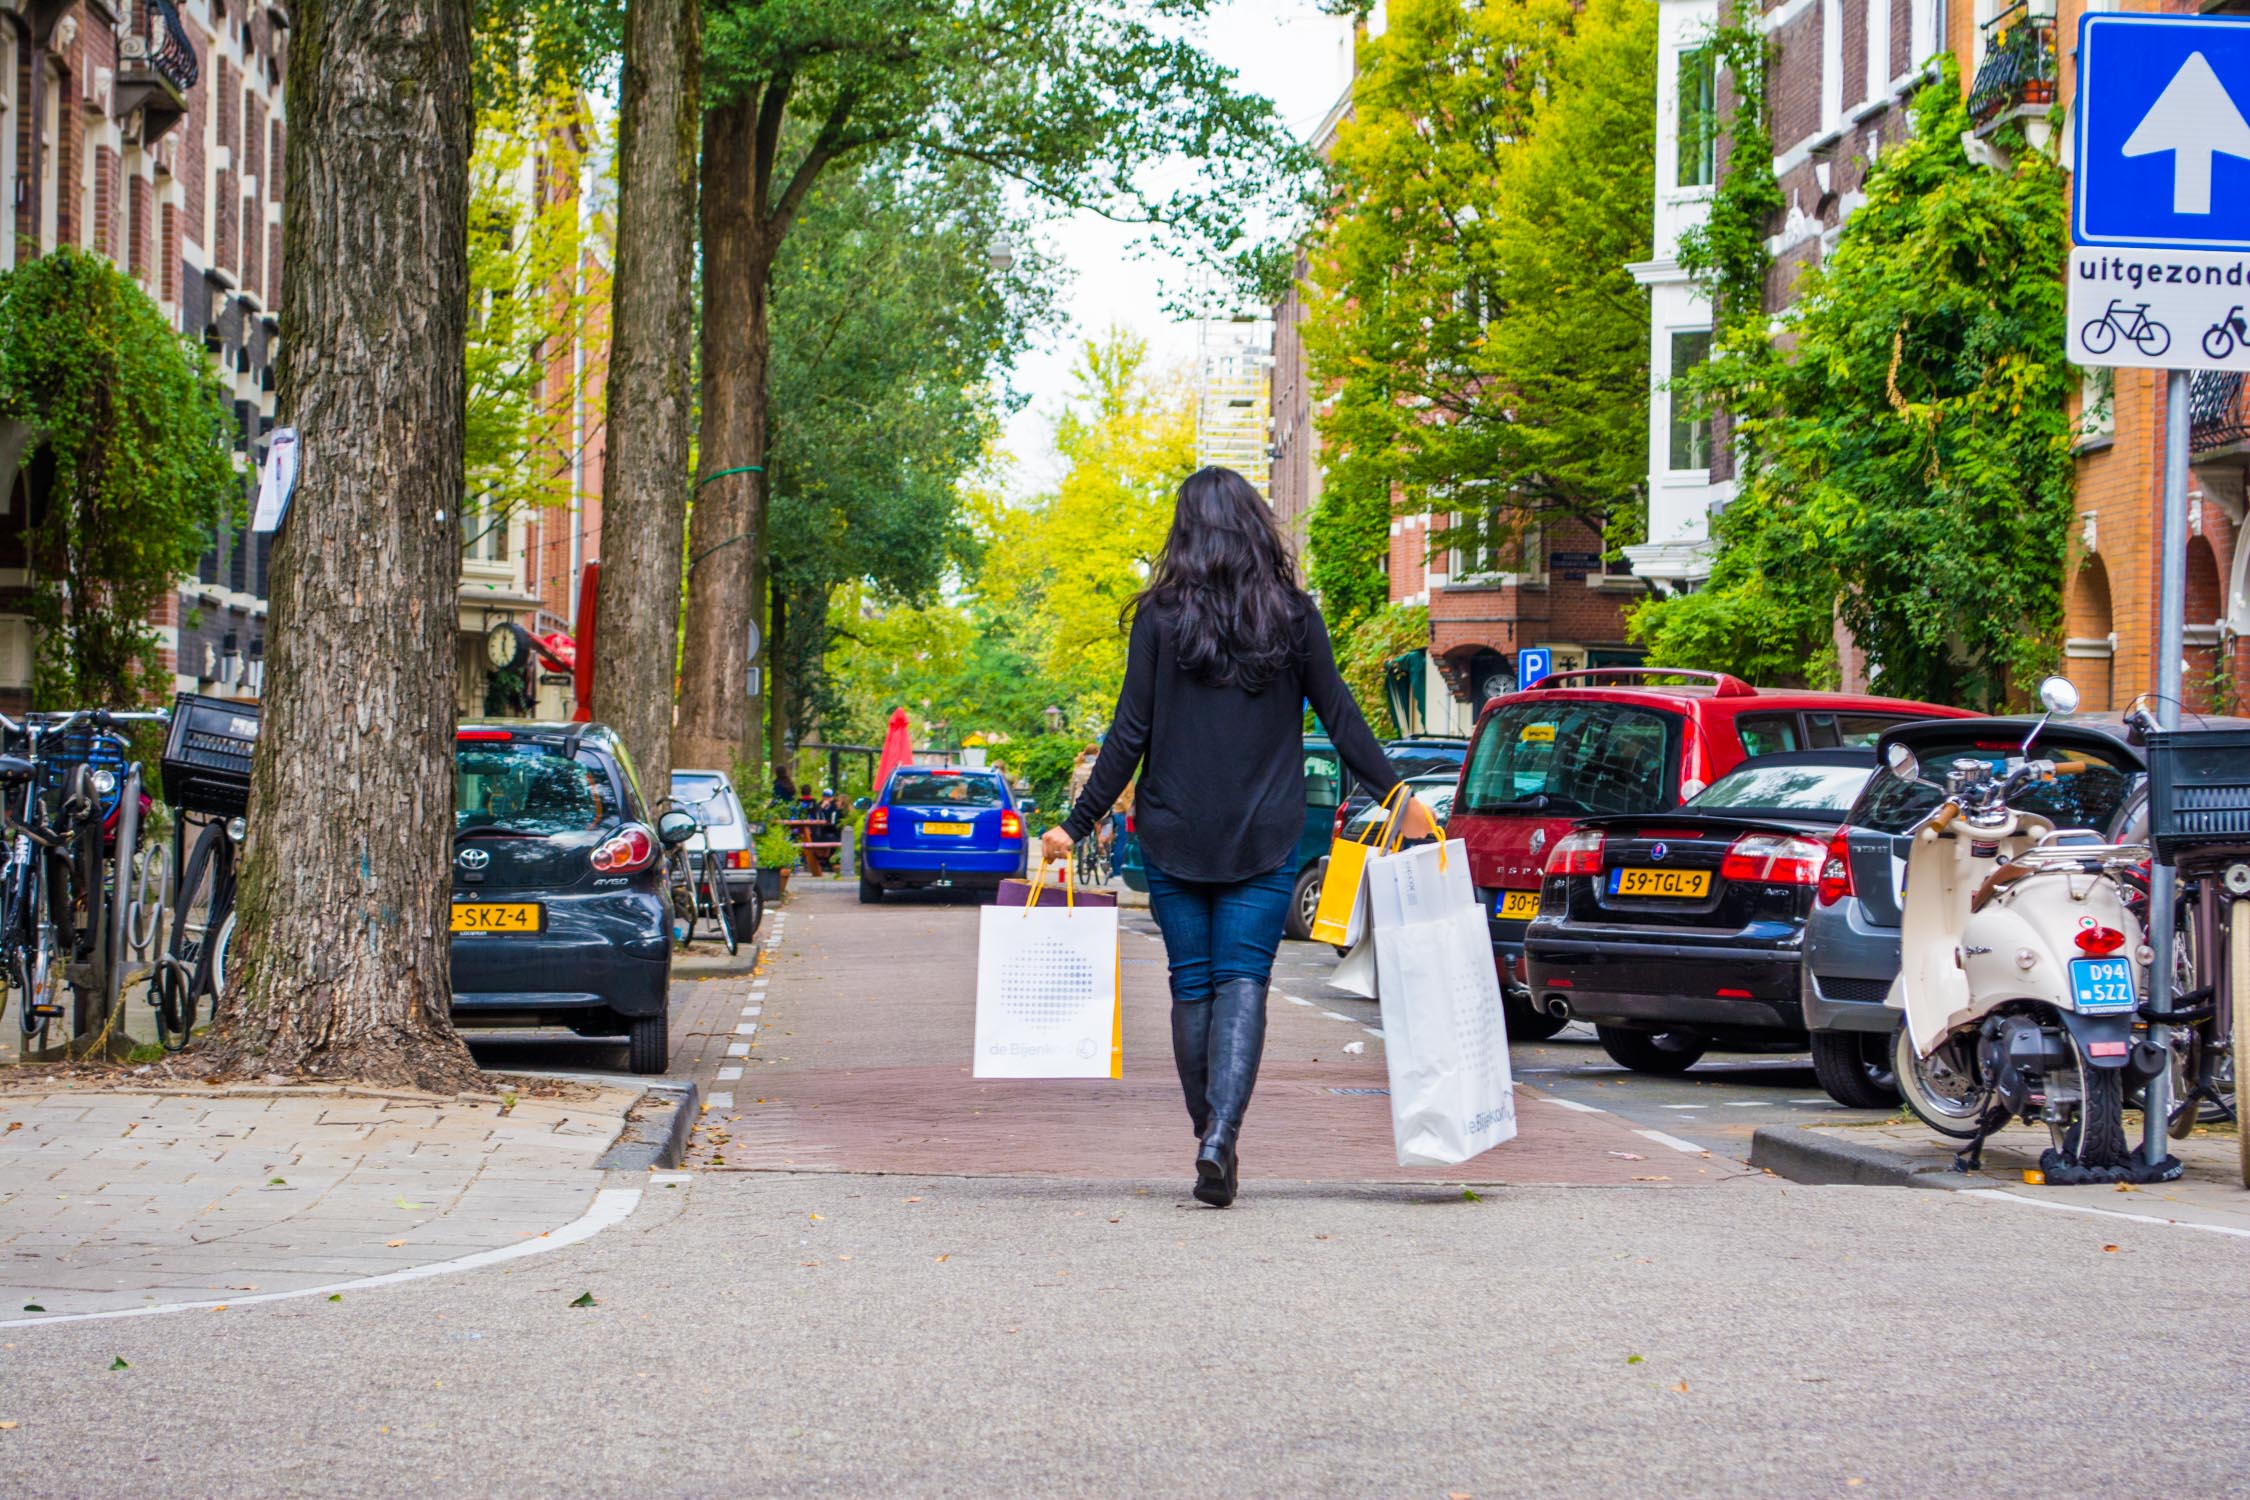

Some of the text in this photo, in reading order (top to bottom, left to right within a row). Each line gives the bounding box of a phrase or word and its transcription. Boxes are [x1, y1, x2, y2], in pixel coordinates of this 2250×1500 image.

[2080, 256, 2250, 290] uitgezond
[1526, 654, 1543, 682] P
[1625, 872, 1702, 893] 59-TGL-9
[450, 908, 528, 927] -SKZ-4
[2090, 964, 2125, 981] D94
[2094, 984, 2128, 1001] 5ZZ
